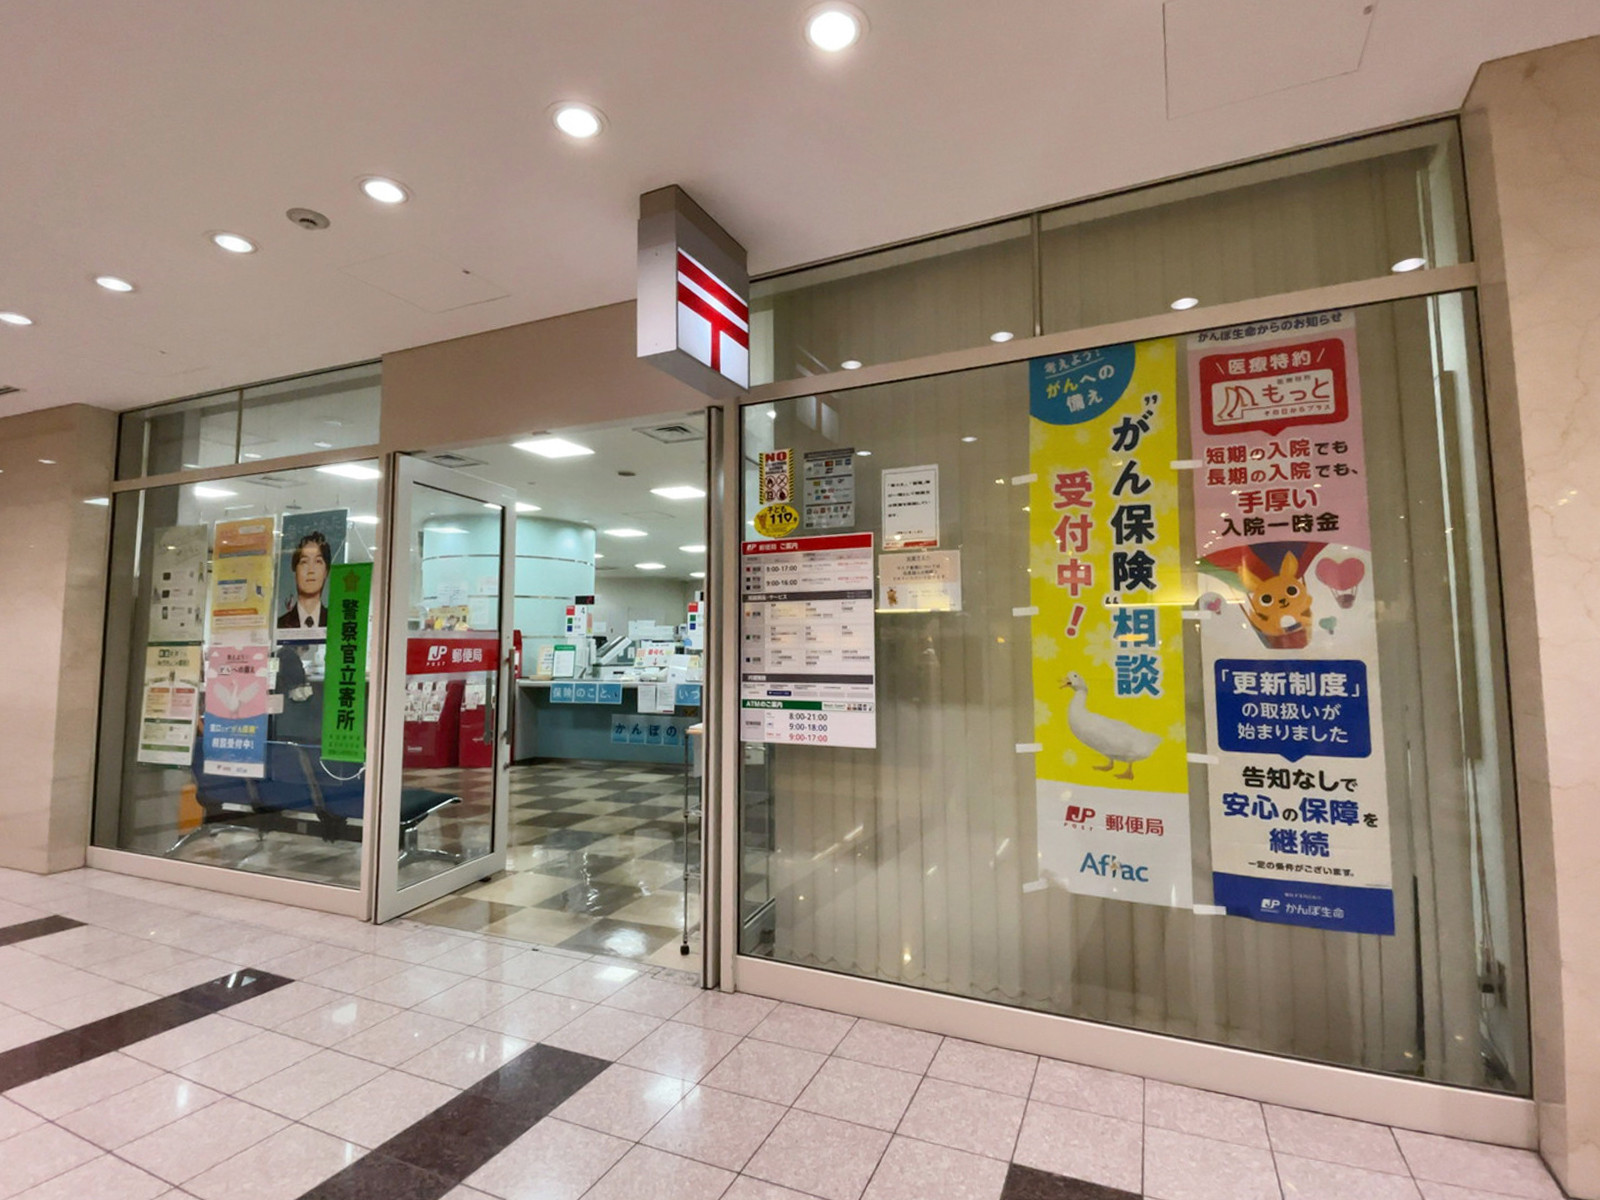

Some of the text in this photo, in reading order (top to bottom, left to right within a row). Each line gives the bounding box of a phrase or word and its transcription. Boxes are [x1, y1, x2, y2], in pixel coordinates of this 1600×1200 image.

[1228, 349, 1311, 376] 医療特約
[1046, 364, 1115, 399] がんへの
[1261, 377, 1330, 404] もっと
[1066, 389, 1103, 413] 備え
[764, 451, 788, 463] NO
[1206, 439, 1348, 465] 短期の入院でも
[1207, 461, 1358, 486] 長期の入院でも、
[767, 505, 788, 514] 子ども
[1238, 488, 1318, 514] 手厚い
[1221, 511, 1339, 536] 入院一時金
[336, 599, 359, 731] 警察官立寄所
[452, 648, 483, 663] 郵便局
[1221, 669, 1361, 698] 「更新制度」
[1242, 702, 1341, 720] の取扱いが
[615, 722, 678, 737] かんぽの
[789, 723, 828, 732] 9:00-18:00
[789, 733, 828, 743] 9:00-17:00
[1237, 722, 1349, 743] 始まりました
[1242, 766, 1358, 793] 告知なしで
[1222, 792, 1379, 828] 安心の保障を
[1105, 813, 1165, 837] 郵便局
[1269, 827, 1330, 858] 継続
[1080, 851, 1149, 883] Aflac
[1248, 860, 1355, 878] 一定の条件がございます。
[1285, 903, 1345, 920] かんぽ生命
